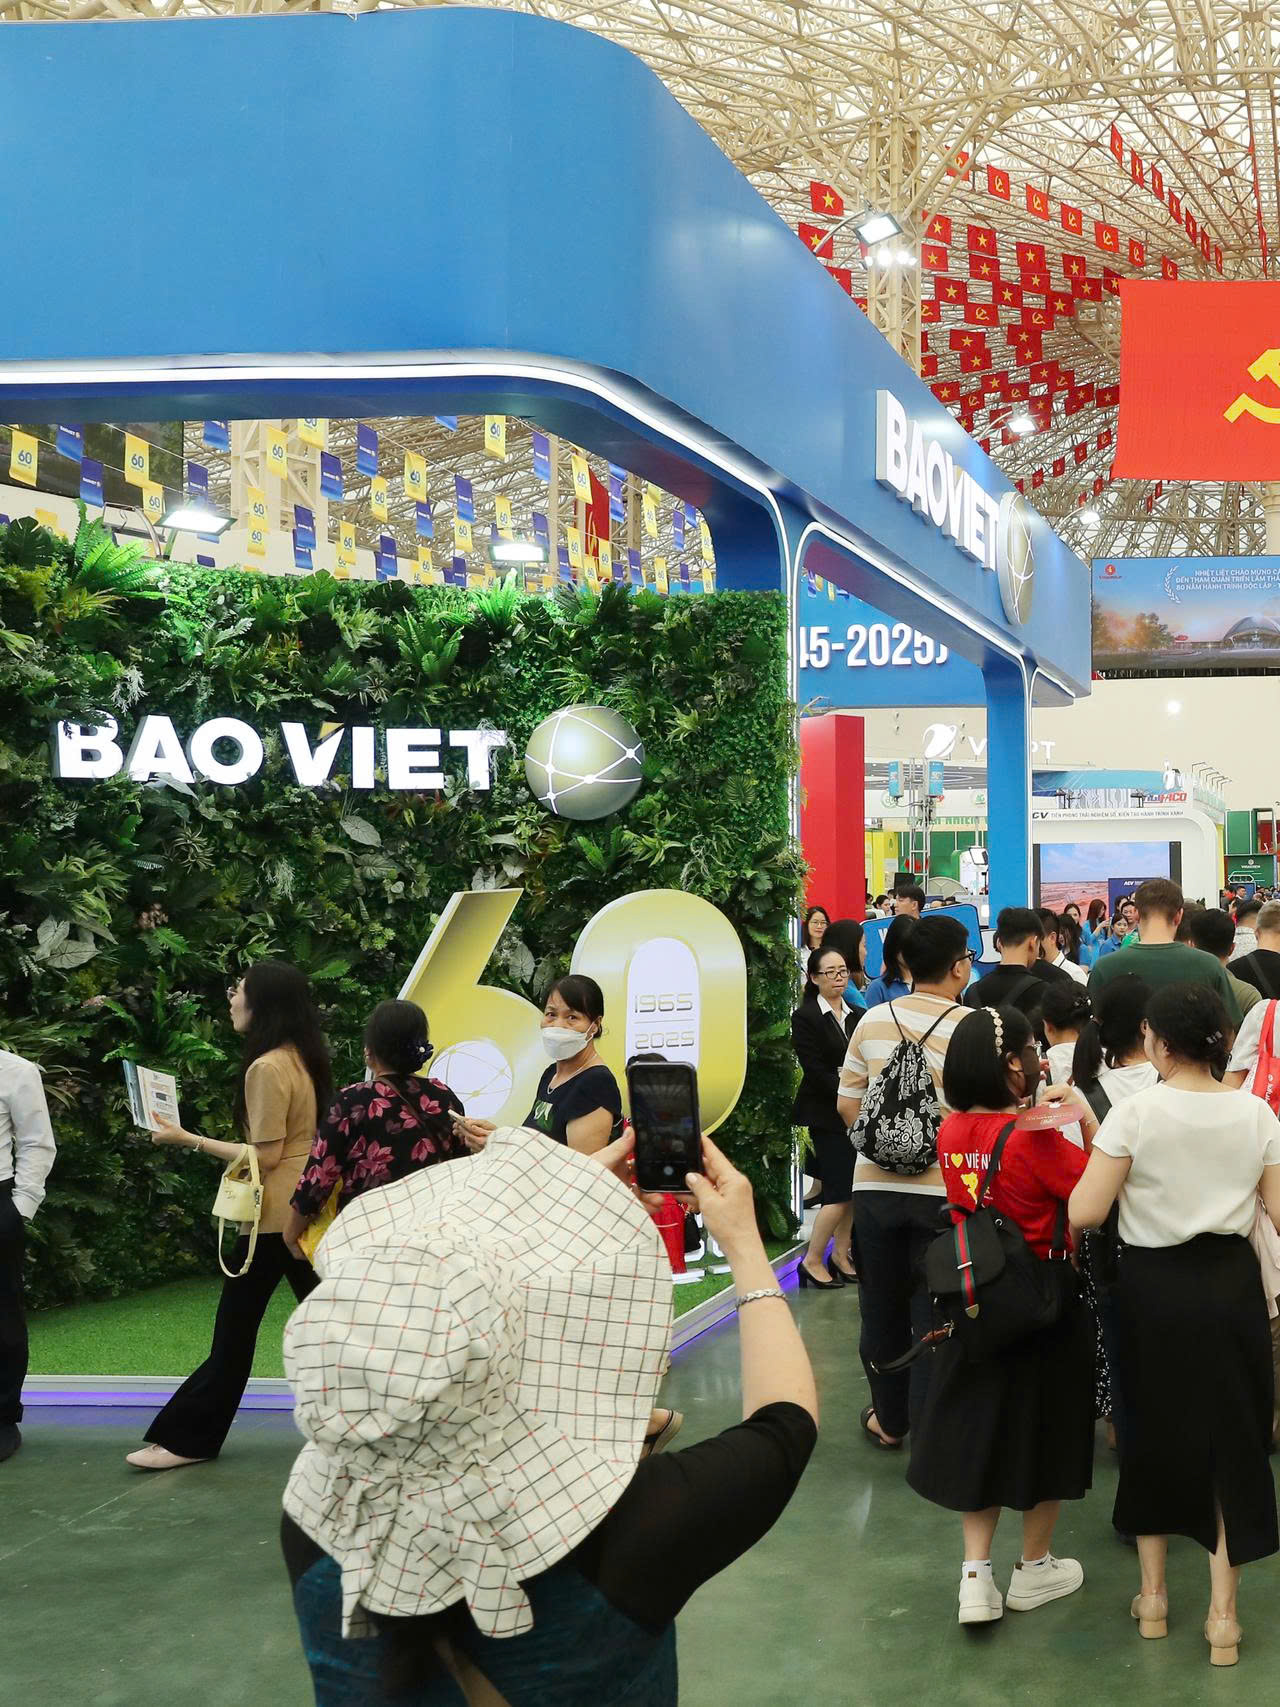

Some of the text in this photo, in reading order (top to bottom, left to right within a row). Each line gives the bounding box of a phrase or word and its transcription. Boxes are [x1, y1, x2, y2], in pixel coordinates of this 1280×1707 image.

[54, 711, 263, 785] BAO
[634, 992, 694, 1014] 1965
[634, 1030, 695, 1050] 2025
